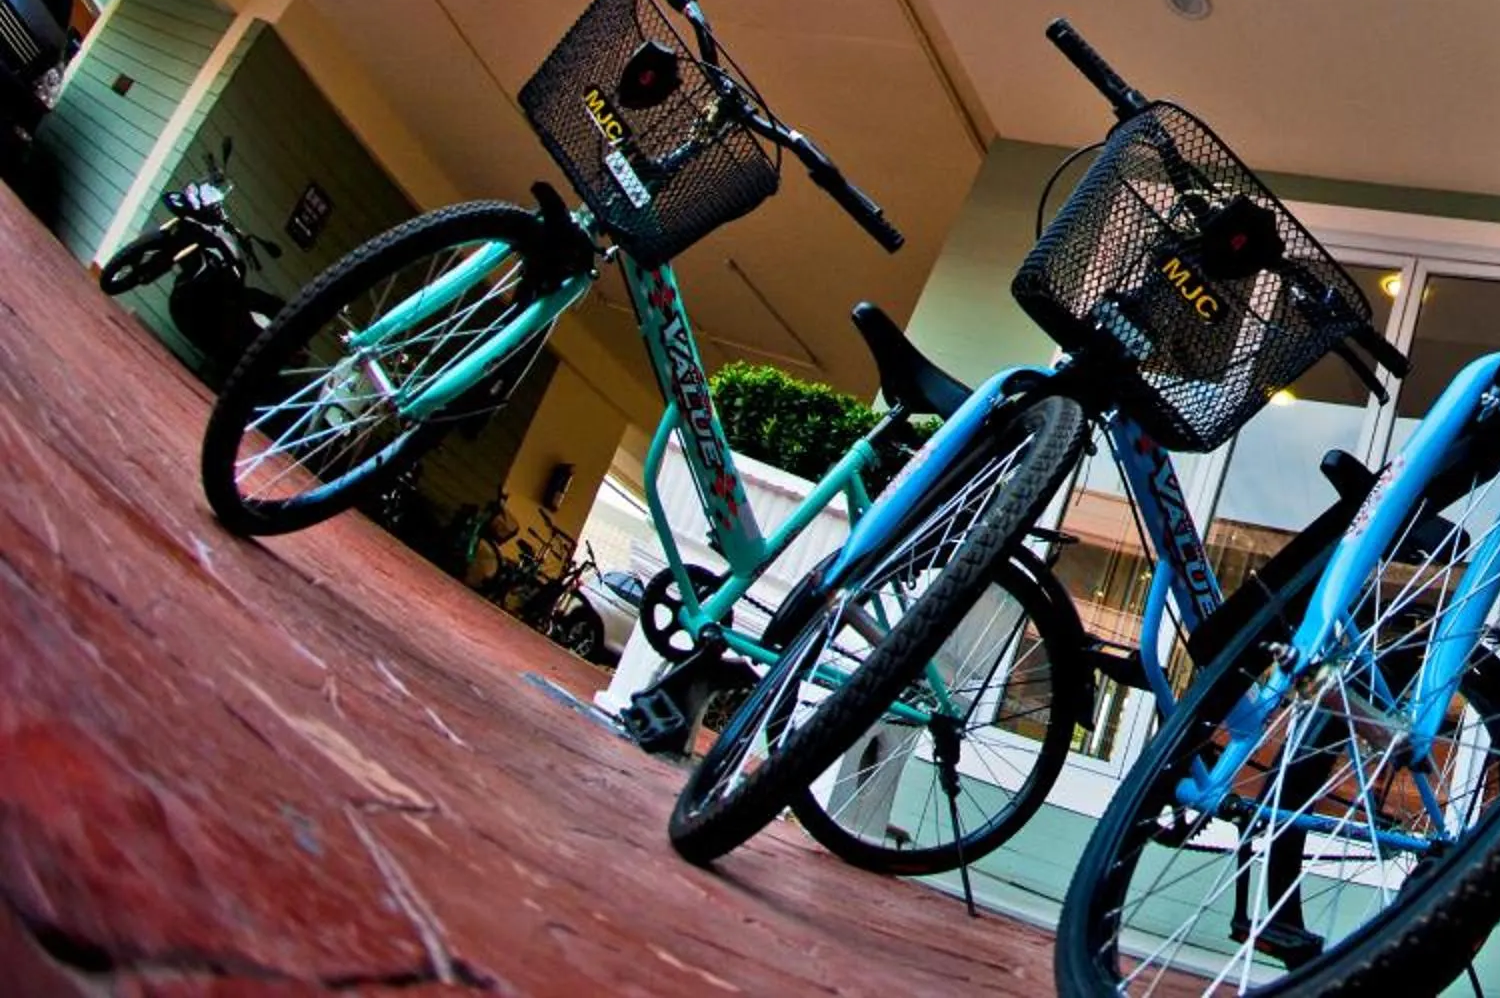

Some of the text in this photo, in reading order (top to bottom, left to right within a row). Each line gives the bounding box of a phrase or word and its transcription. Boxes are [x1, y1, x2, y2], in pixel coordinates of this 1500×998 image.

[585, 89, 623, 141] MJC
[1162, 256, 1219, 321] MJC
[660, 311, 722, 468] VALUE
[1152, 451, 1216, 620] VALUE
